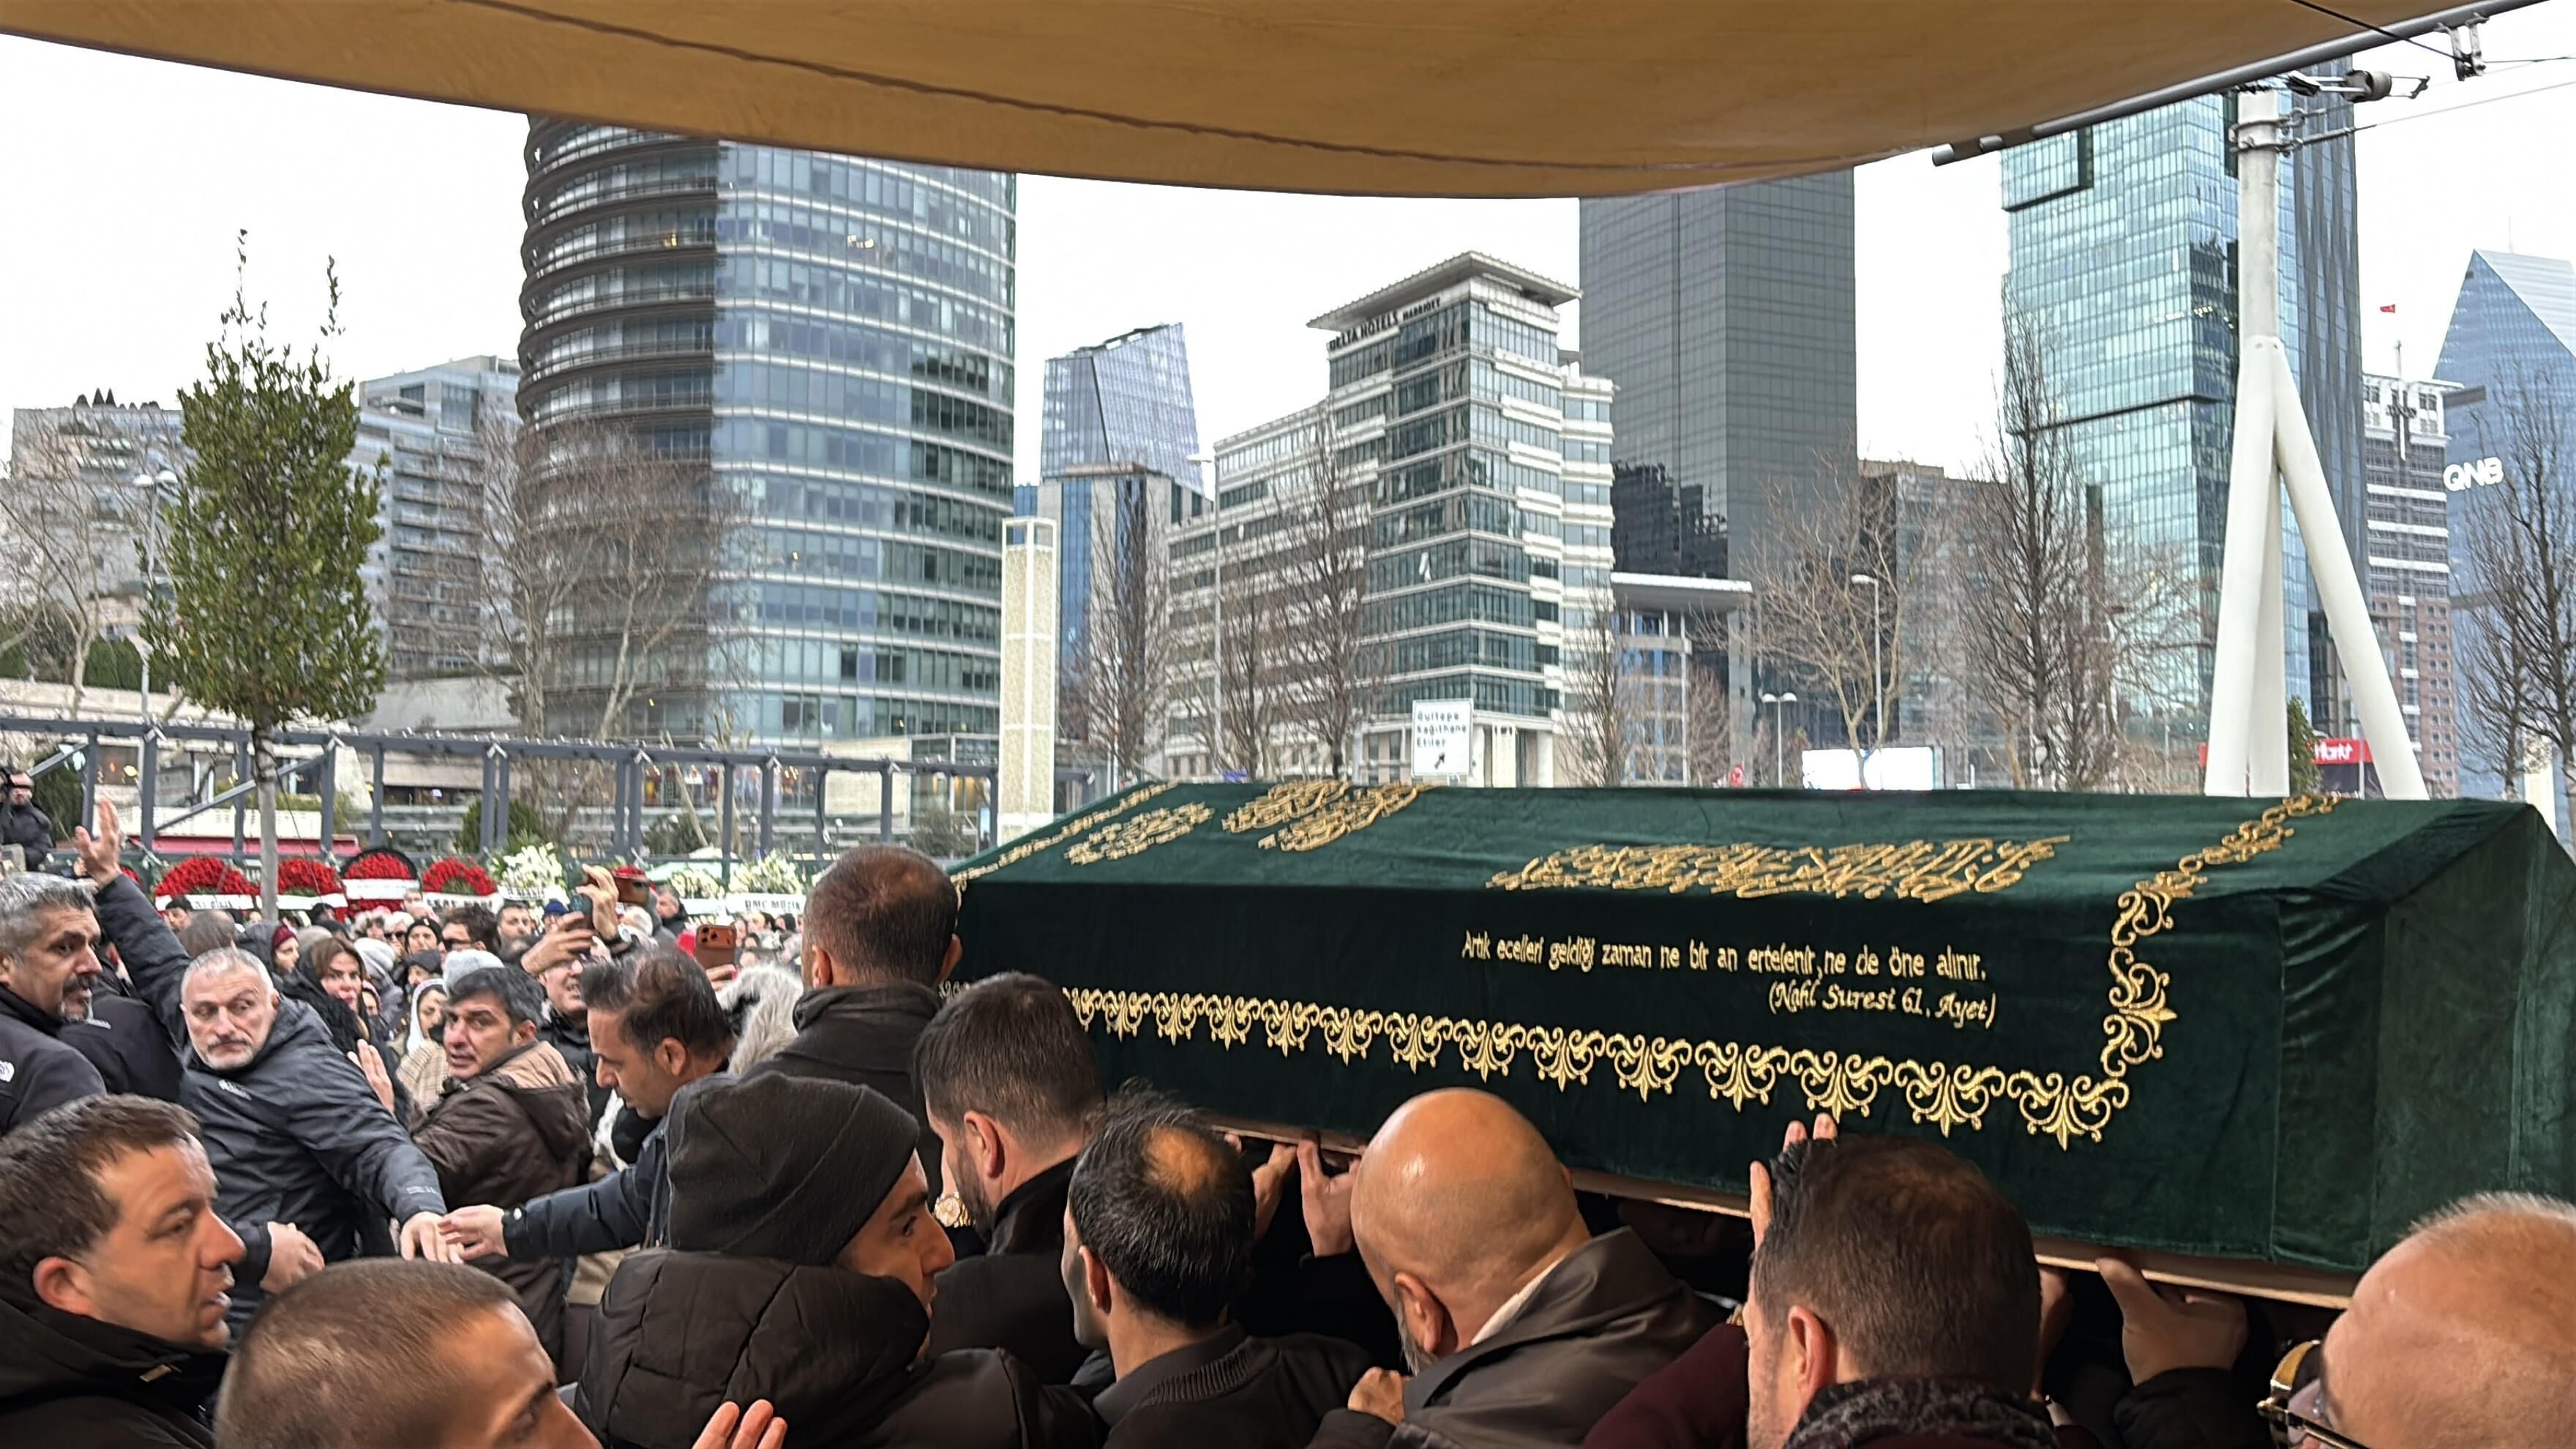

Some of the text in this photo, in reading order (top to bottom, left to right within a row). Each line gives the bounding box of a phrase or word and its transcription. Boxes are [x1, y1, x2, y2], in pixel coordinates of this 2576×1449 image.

[1360, 310, 1399, 337] HOTELS
[2443, 457, 2504, 491] QNB
[1497, 933, 1544, 964] ecelleri
[1549, 935, 1595, 973] geldiği
[1602, 943, 1652, 968] zaman
[1660, 944, 1680, 970] ne
[1689, 938, 1709, 970] bir
[1717, 946, 1738, 972] an
[1855, 944, 1879, 976] de
[1889, 946, 1925, 978] öne
[1936, 944, 1986, 981] alınır.
[1822, 984, 1897, 1011] Suresi
[1934, 992, 1996, 1029] Ayet)
